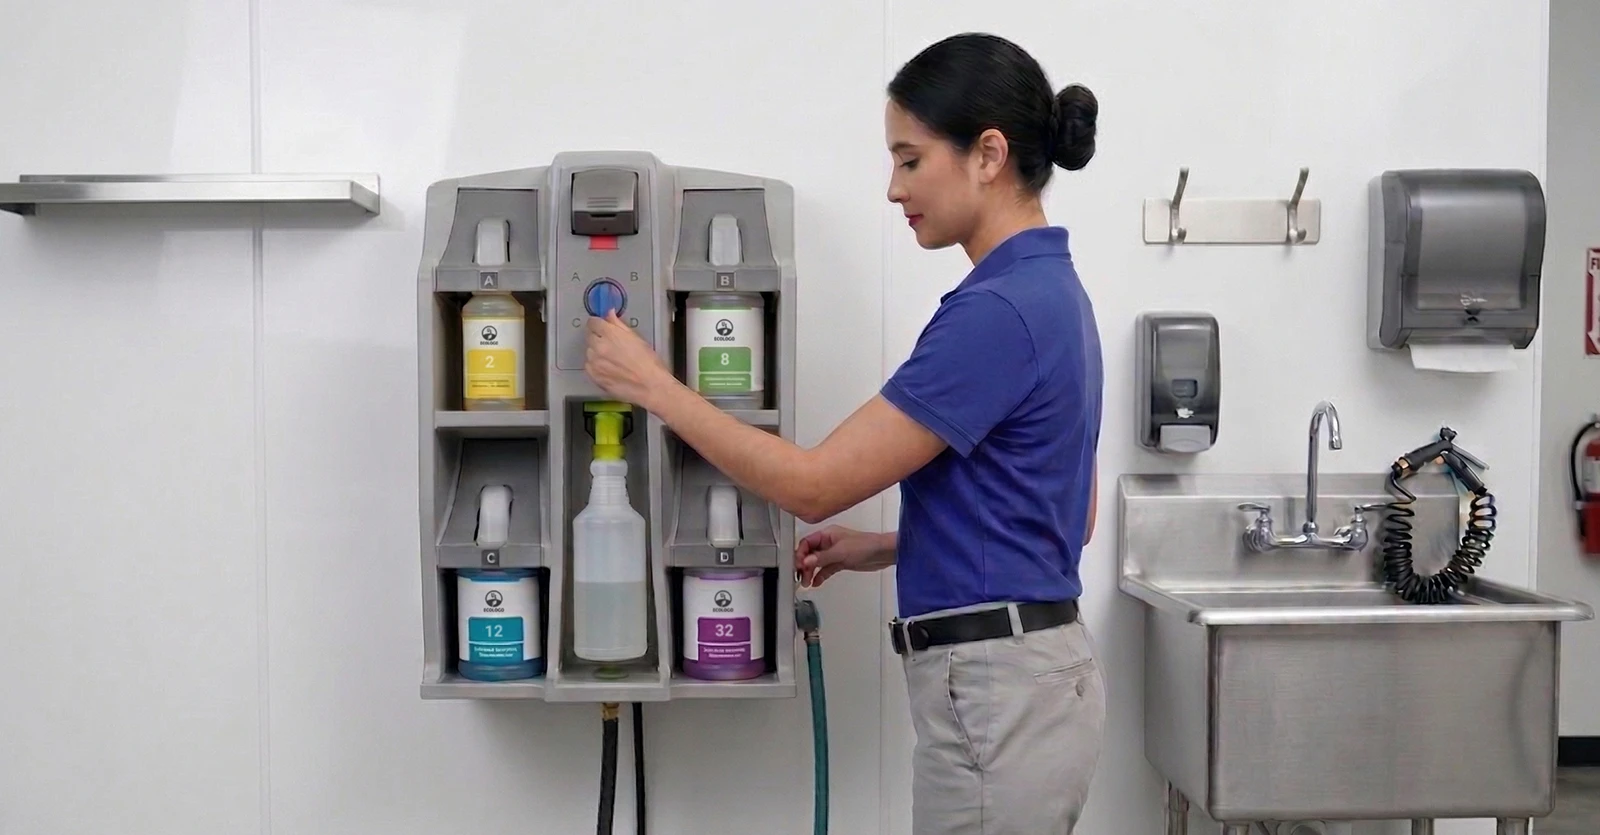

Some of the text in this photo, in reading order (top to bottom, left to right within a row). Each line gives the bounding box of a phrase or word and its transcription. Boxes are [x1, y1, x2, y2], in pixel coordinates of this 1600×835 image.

[484, 275, 493, 286] A
[572, 272, 581, 281] A
[630, 271, 639, 281] B
[721, 275, 730, 286] B
[572, 318, 581, 328] C
[630, 317, 639, 328] D
[485, 355, 495, 368] 2
[721, 352, 729, 366] 8
[487, 552, 495, 563] C
[720, 552, 729, 562] D
[485, 625, 503, 638] 12
[715, 624, 734, 637] 32
